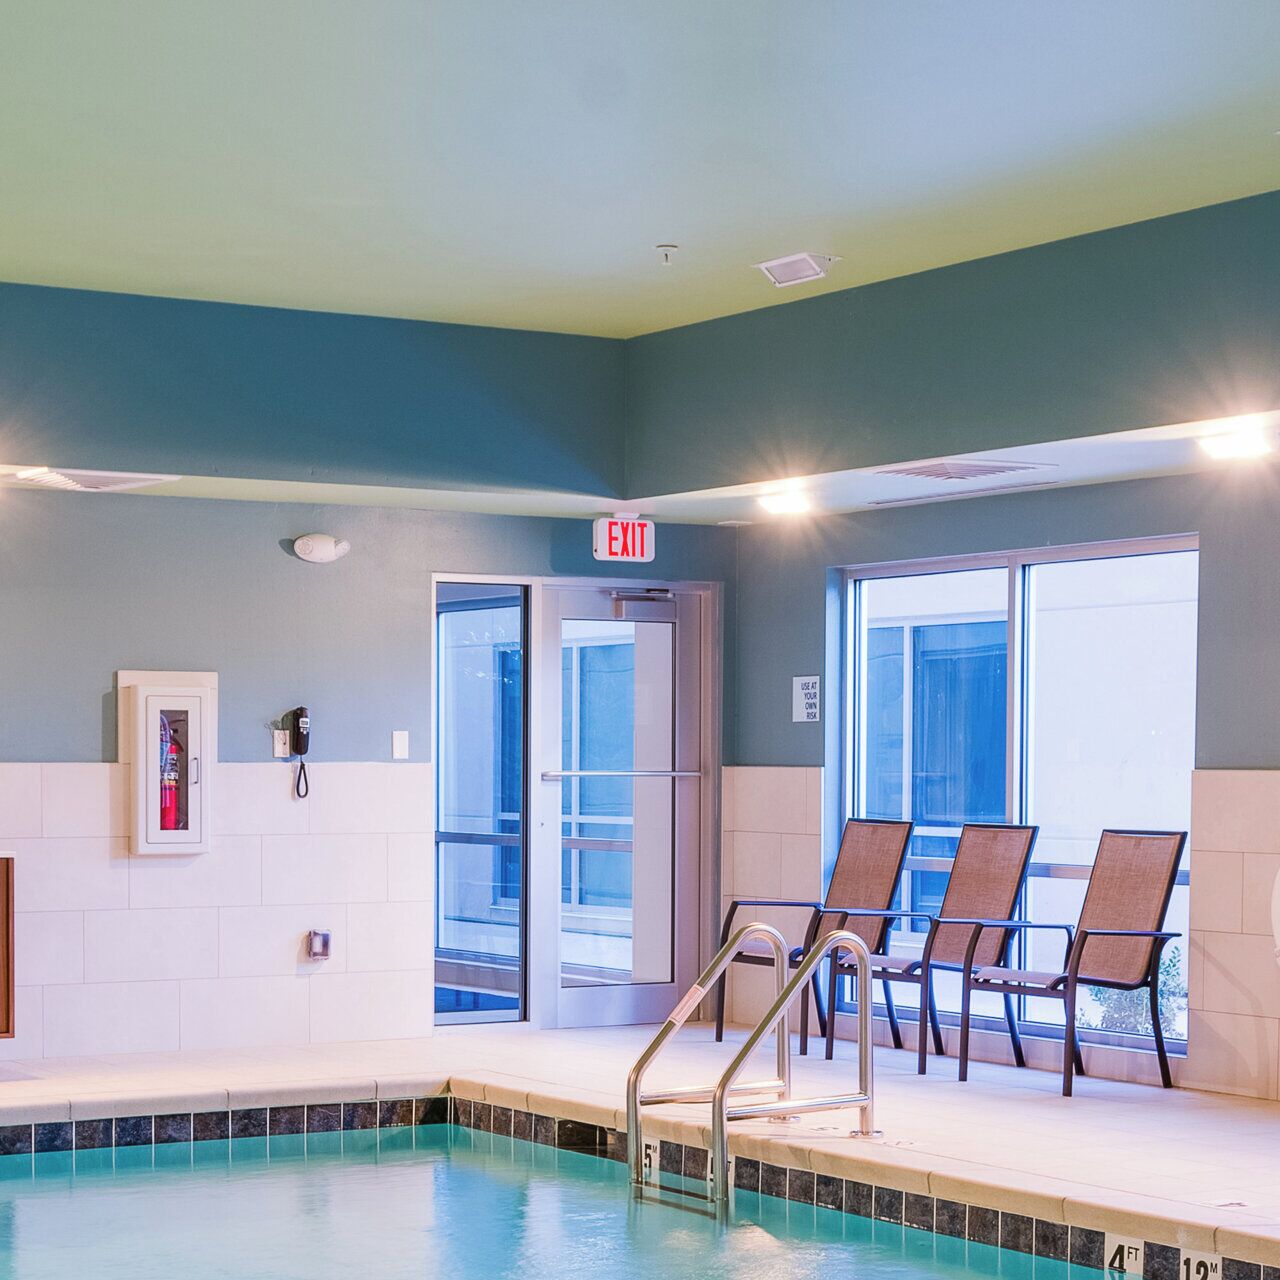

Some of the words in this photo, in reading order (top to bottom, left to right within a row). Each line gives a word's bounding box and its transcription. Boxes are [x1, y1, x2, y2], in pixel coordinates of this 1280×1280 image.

[608, 520, 647, 558] EXIT
[800, 681, 810, 691] USE
[810, 681, 817, 690] AT
[804, 691, 818, 700] YOUR
[805, 701, 818, 711] OWN
[806, 711, 818, 720] RISK
[1108, 1243, 1127, 1274] 4
